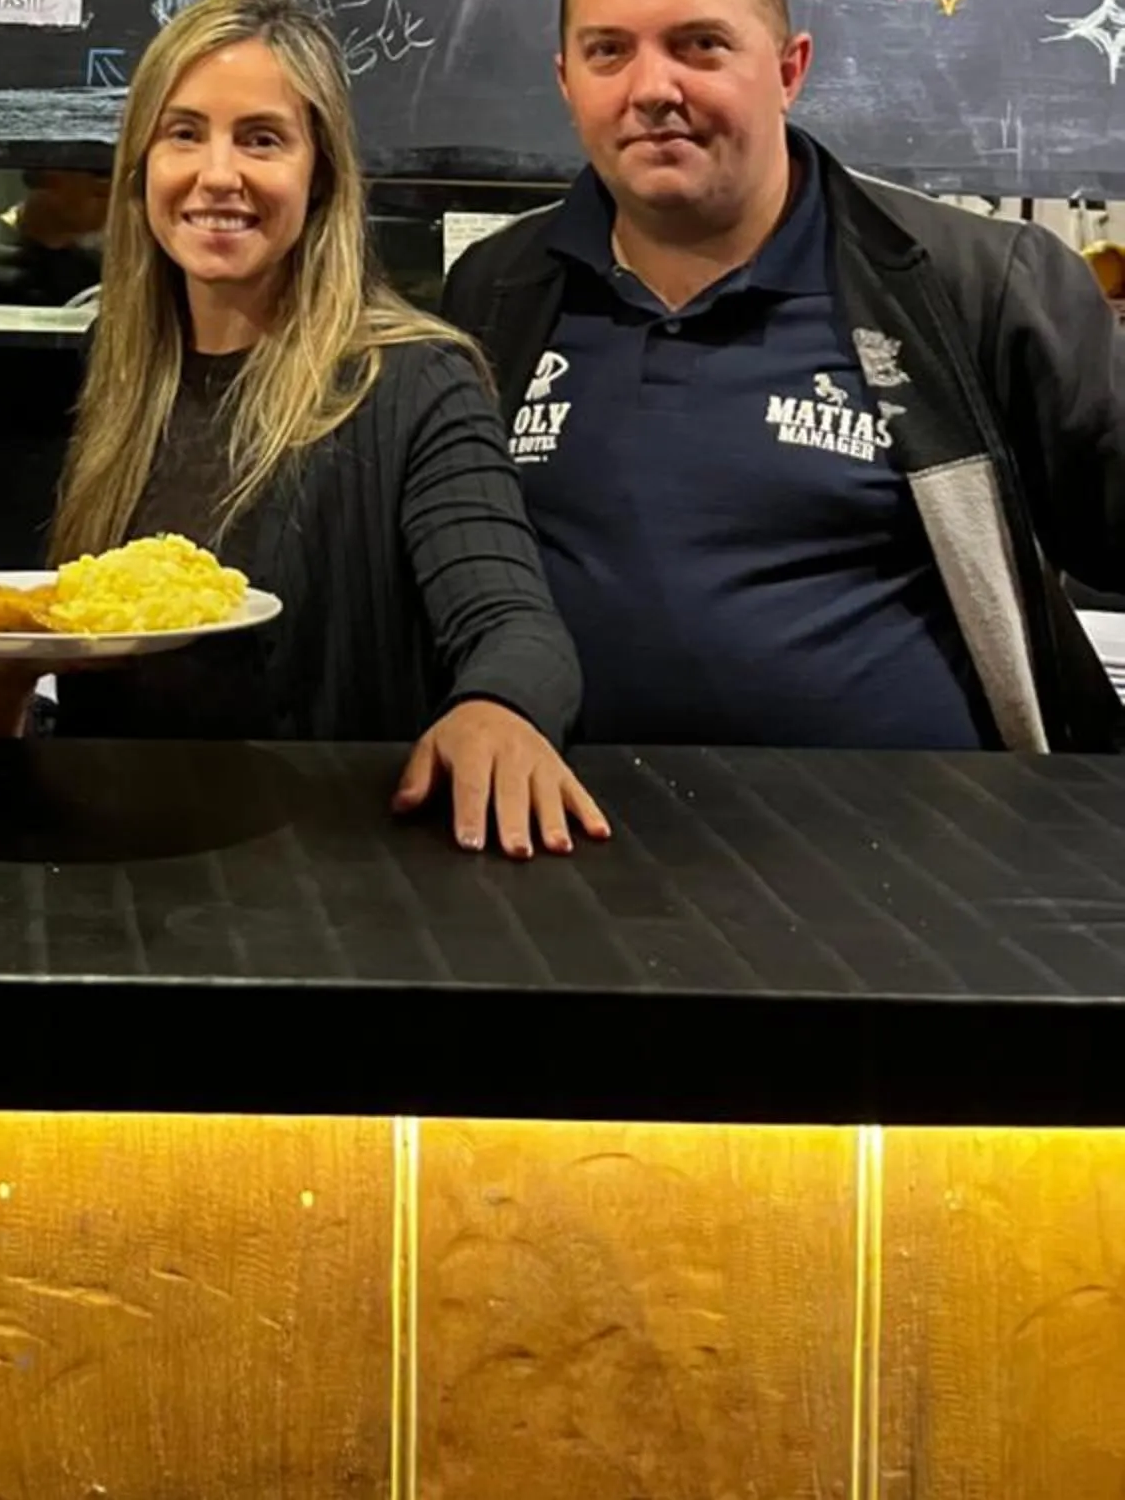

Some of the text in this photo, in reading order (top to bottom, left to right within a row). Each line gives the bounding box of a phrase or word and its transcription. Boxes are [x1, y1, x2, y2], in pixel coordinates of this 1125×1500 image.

[513, 401, 572, 436] OLY
[764, 394, 894, 449] MATIAS
[778, 421, 874, 462] MANAGER
